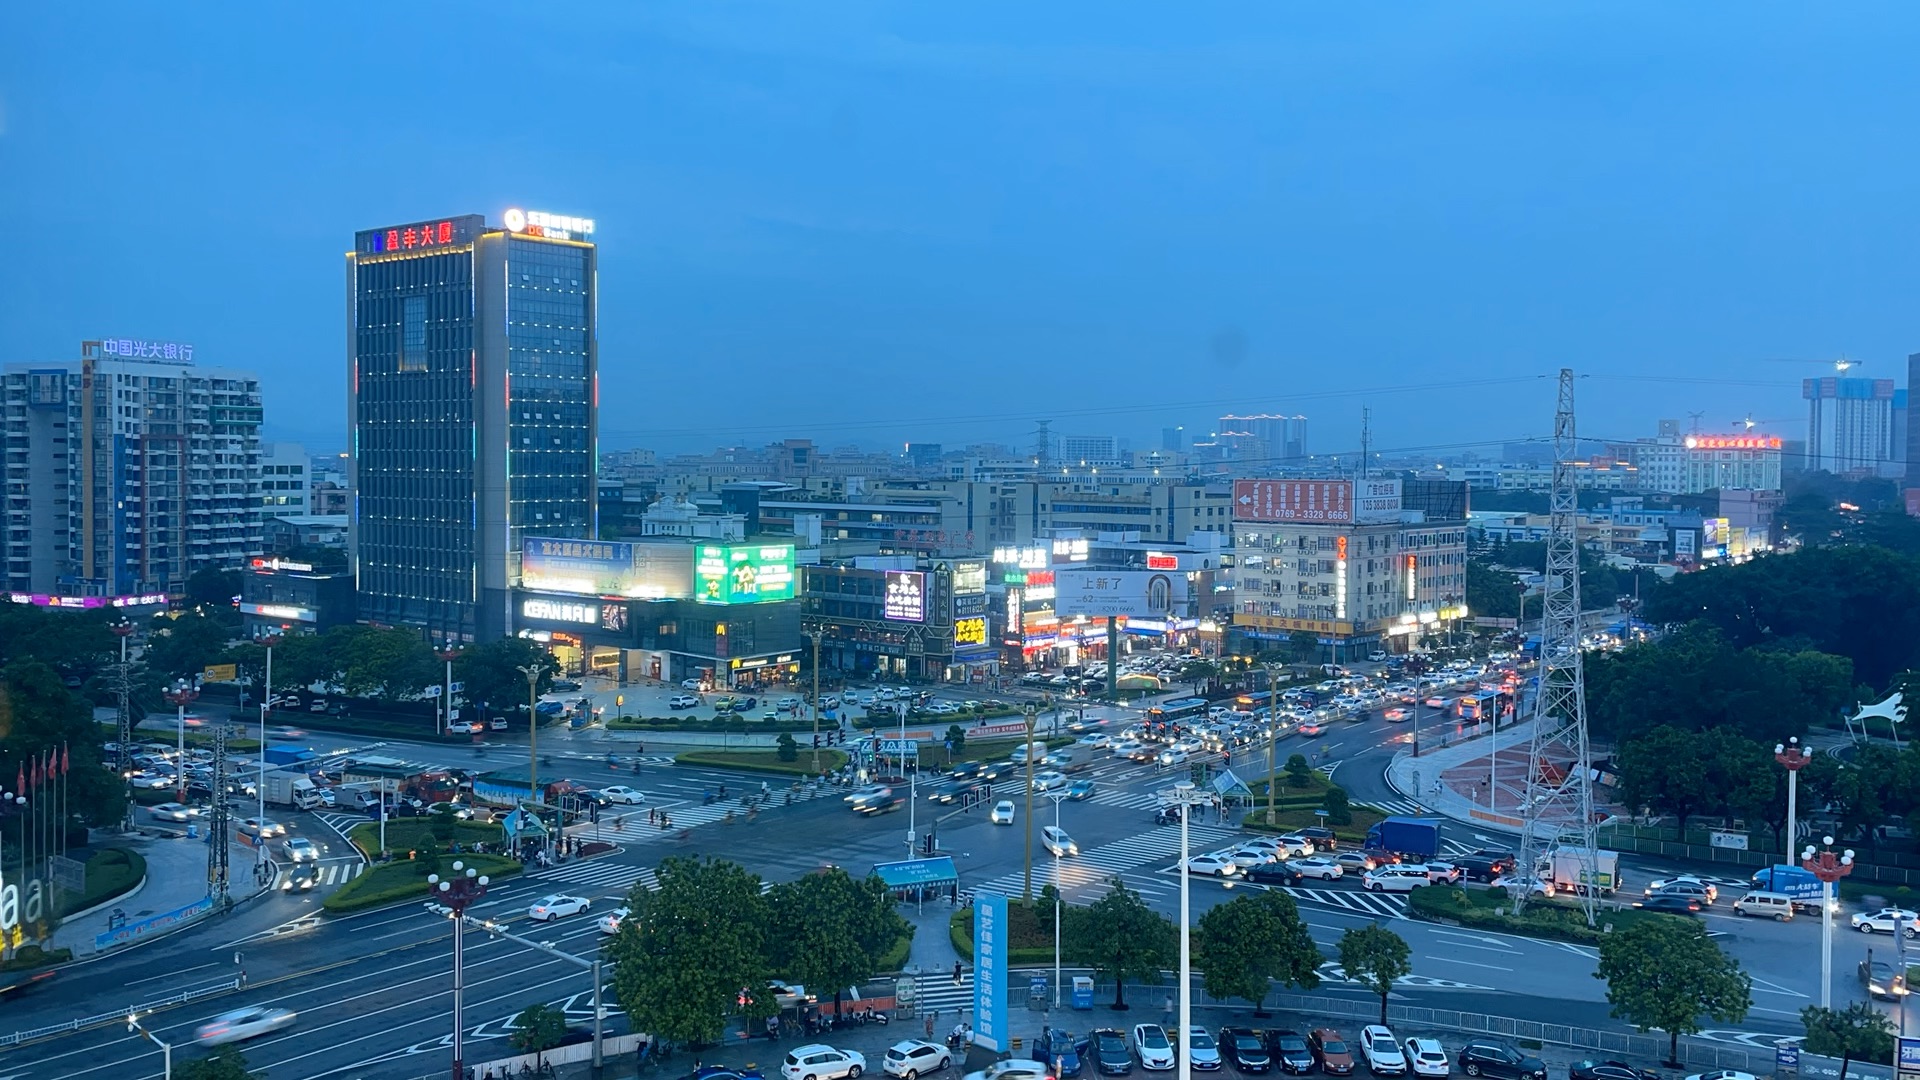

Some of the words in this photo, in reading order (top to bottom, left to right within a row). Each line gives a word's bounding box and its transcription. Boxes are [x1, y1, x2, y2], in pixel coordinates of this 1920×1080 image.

[387, 222, 452, 251] 盈丰大厦
[103, 338, 193, 361] 中国光大银行
[1366, 483, 1395, 496] 广告位招租
[1327, 511, 1349, 520] 6666
[1337, 536, 1347, 560] OYO
[1082, 577, 1122, 590] 上新了
[1082, 595, 1094, 603] 62
[980, 903, 993, 1036] 星艺佳家居生活体验馆
